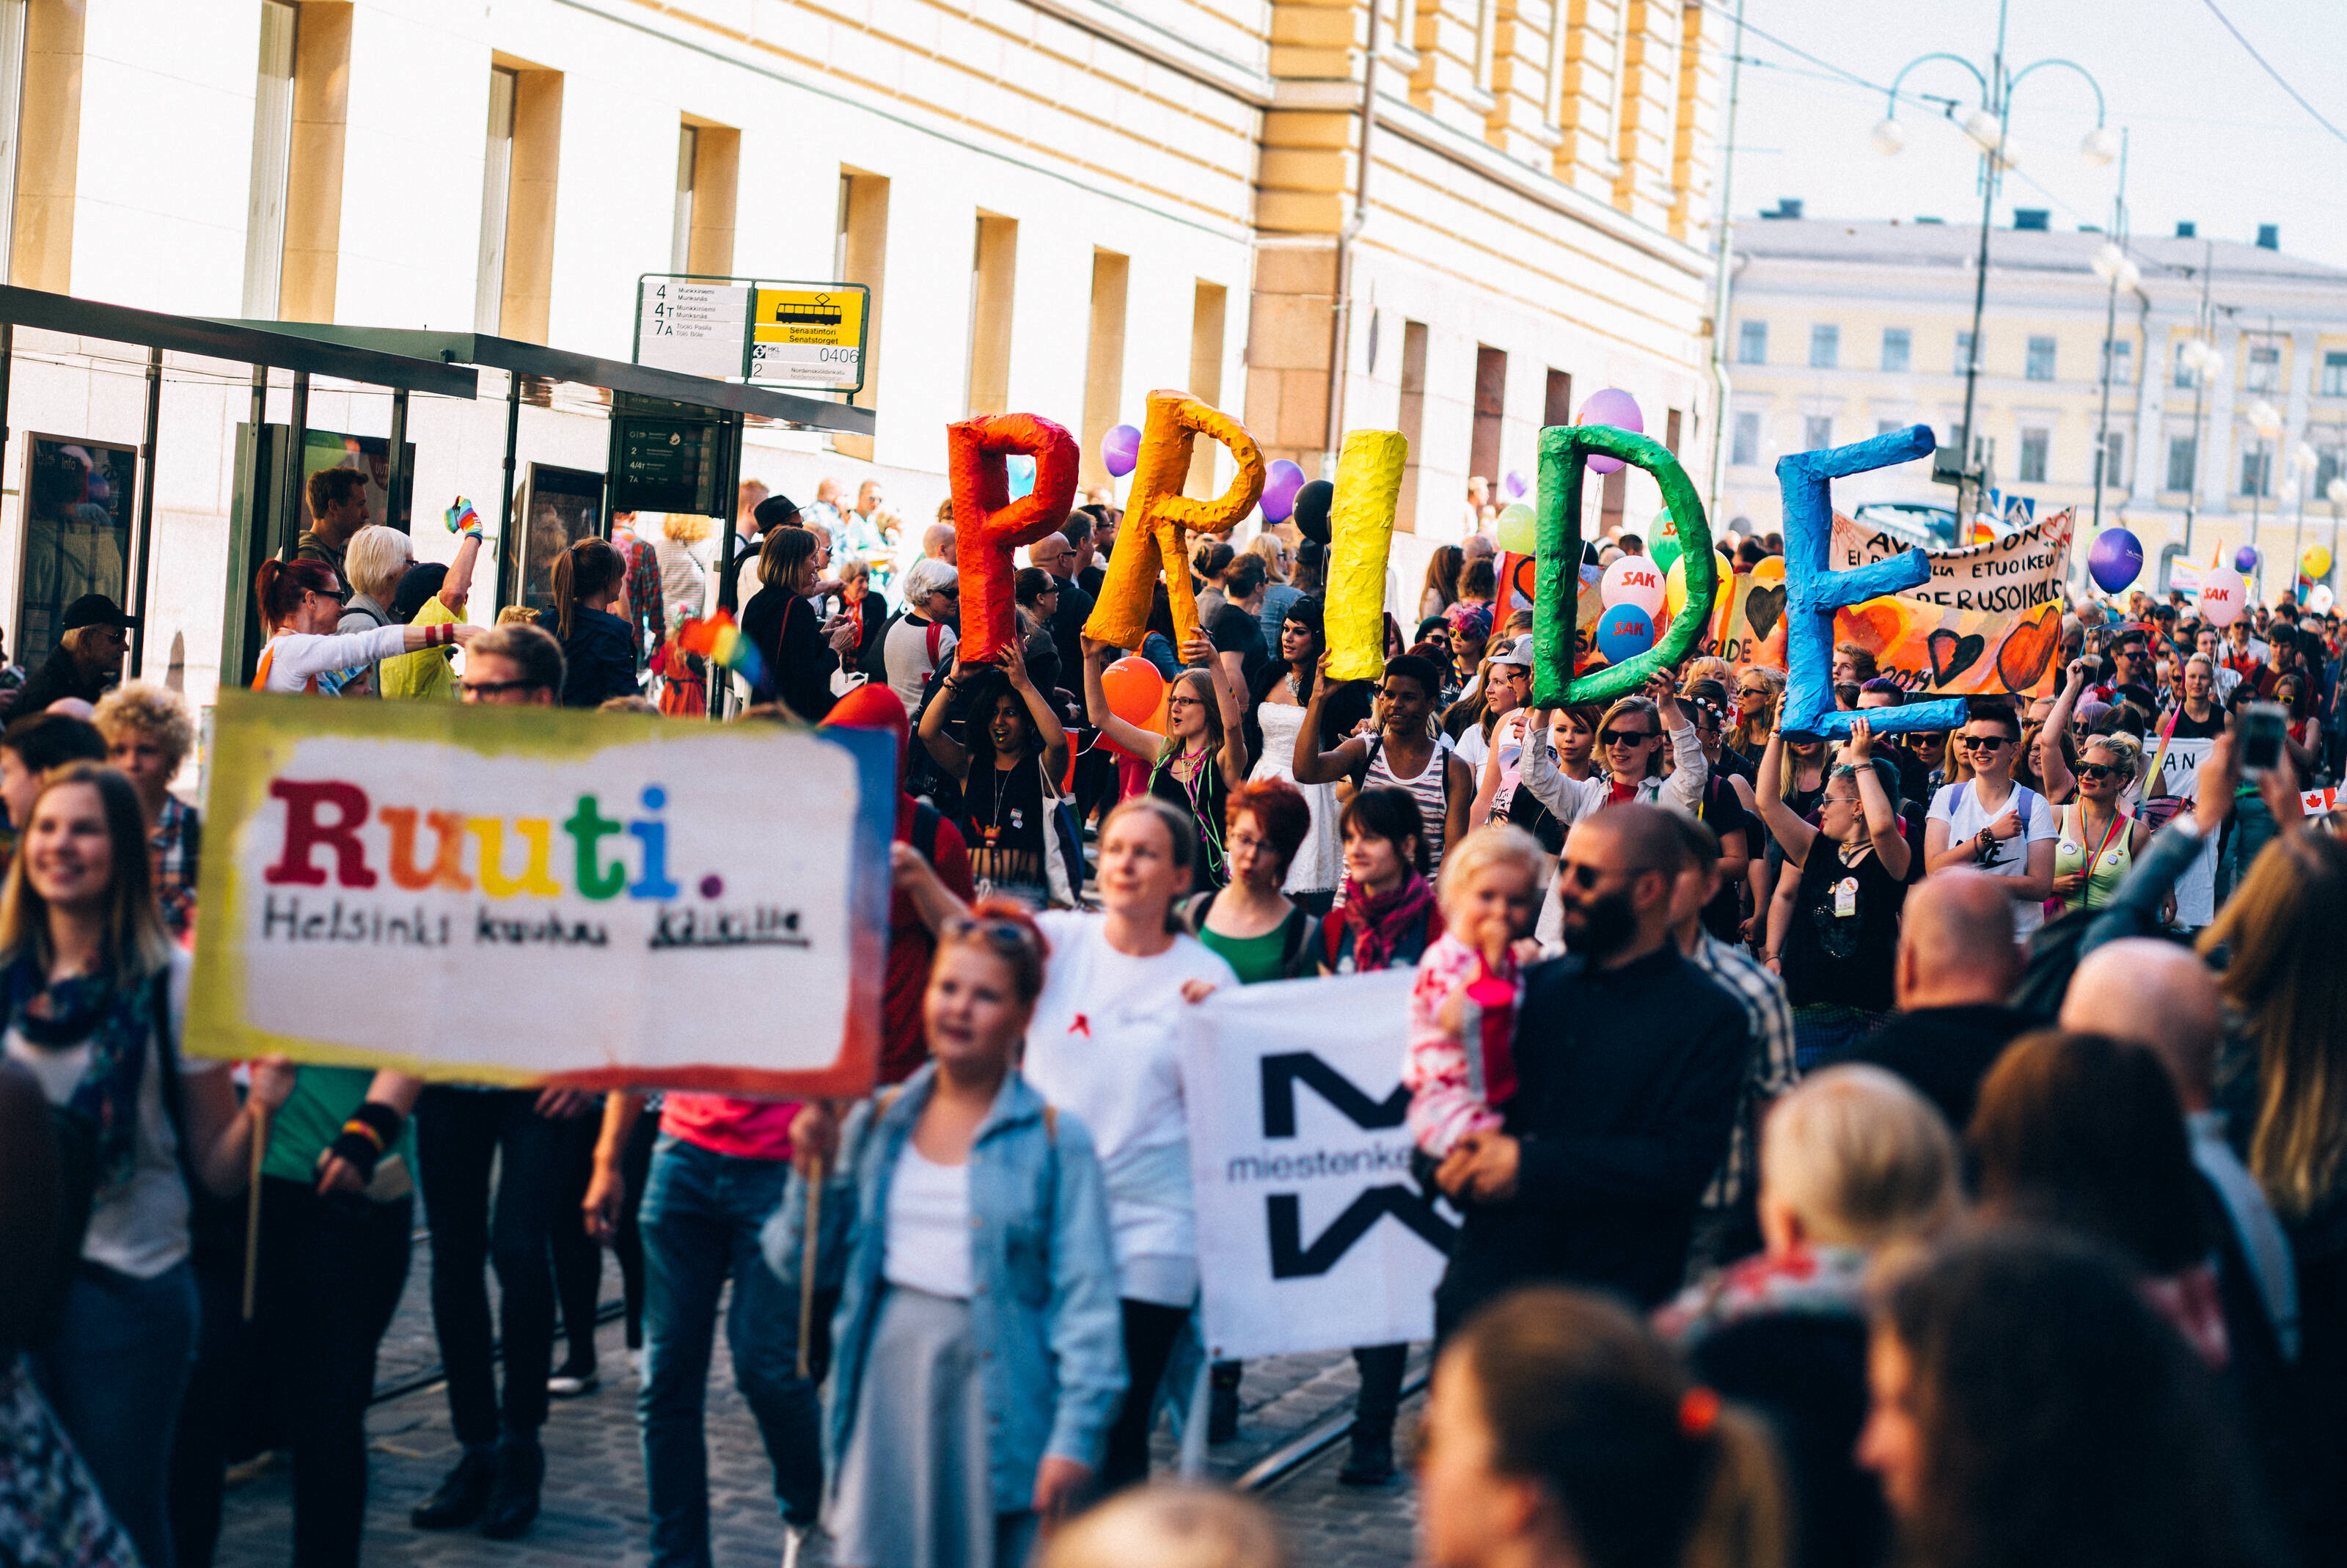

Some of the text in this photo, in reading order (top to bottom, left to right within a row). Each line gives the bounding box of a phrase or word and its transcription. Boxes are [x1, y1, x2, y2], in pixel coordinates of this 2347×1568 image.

[656, 284, 666, 299] 4
[676, 304, 716, 312] Munkkiniemi
[655, 320, 673, 335] 7A
[790, 326, 836, 335] Senaatintori
[789, 335, 838, 345] Senatstorget
[819, 348, 859, 364] 0406
[753, 363, 763, 377] 2
[631, 447, 637, 455] 2
[61, 457, 76, 470] Info
[1621, 571, 1655, 589] SAK
[2203, 587, 2230, 601] SAK
[1612, 621, 1644, 636] SAK
[263, 894, 451, 947] Helsinki
